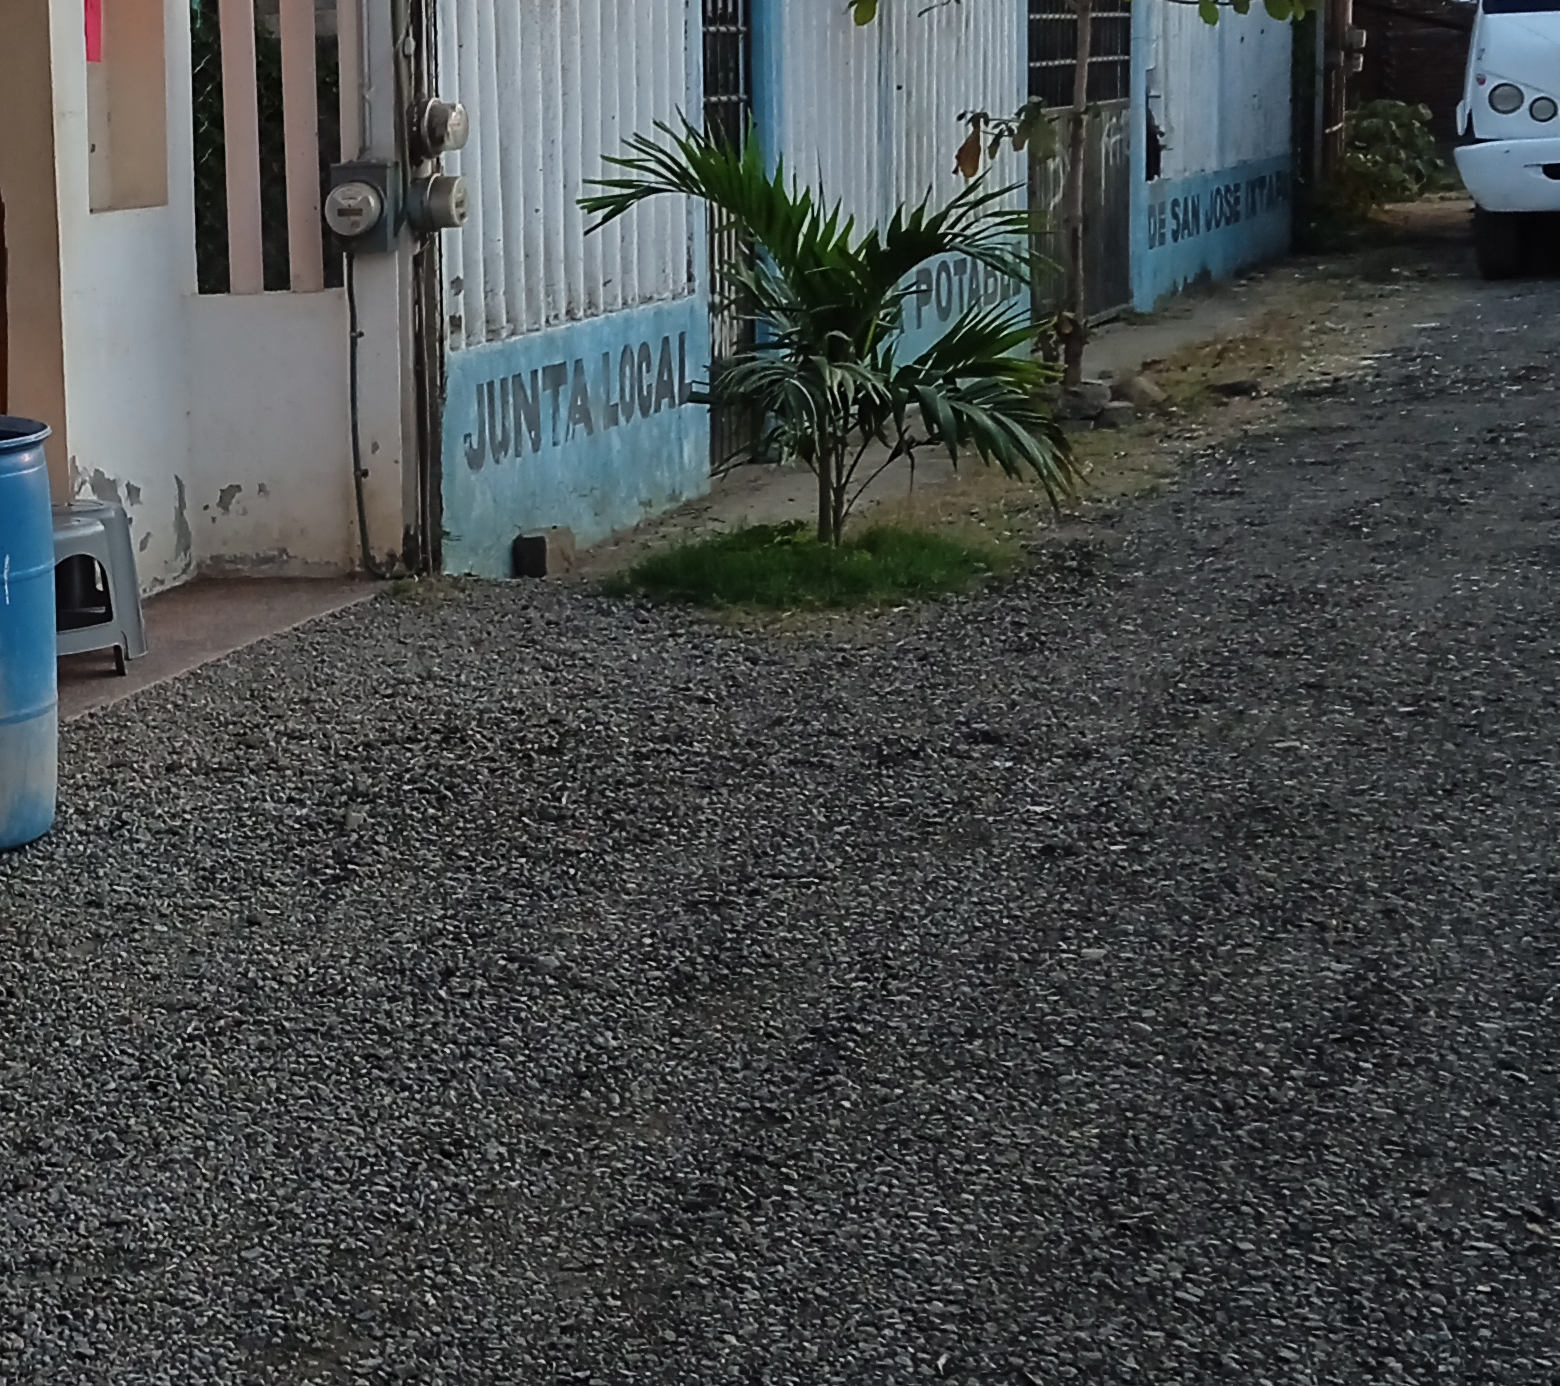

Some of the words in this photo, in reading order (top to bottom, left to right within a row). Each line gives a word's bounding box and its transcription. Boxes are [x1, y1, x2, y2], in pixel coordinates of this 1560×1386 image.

[1148, 200, 1166, 250] DE
[1171, 194, 1200, 243] SAN
[1205, 182, 1241, 232] JOSE
[463, 359, 595, 471] JUNTA
[602, 331, 690, 431] LOCAL
